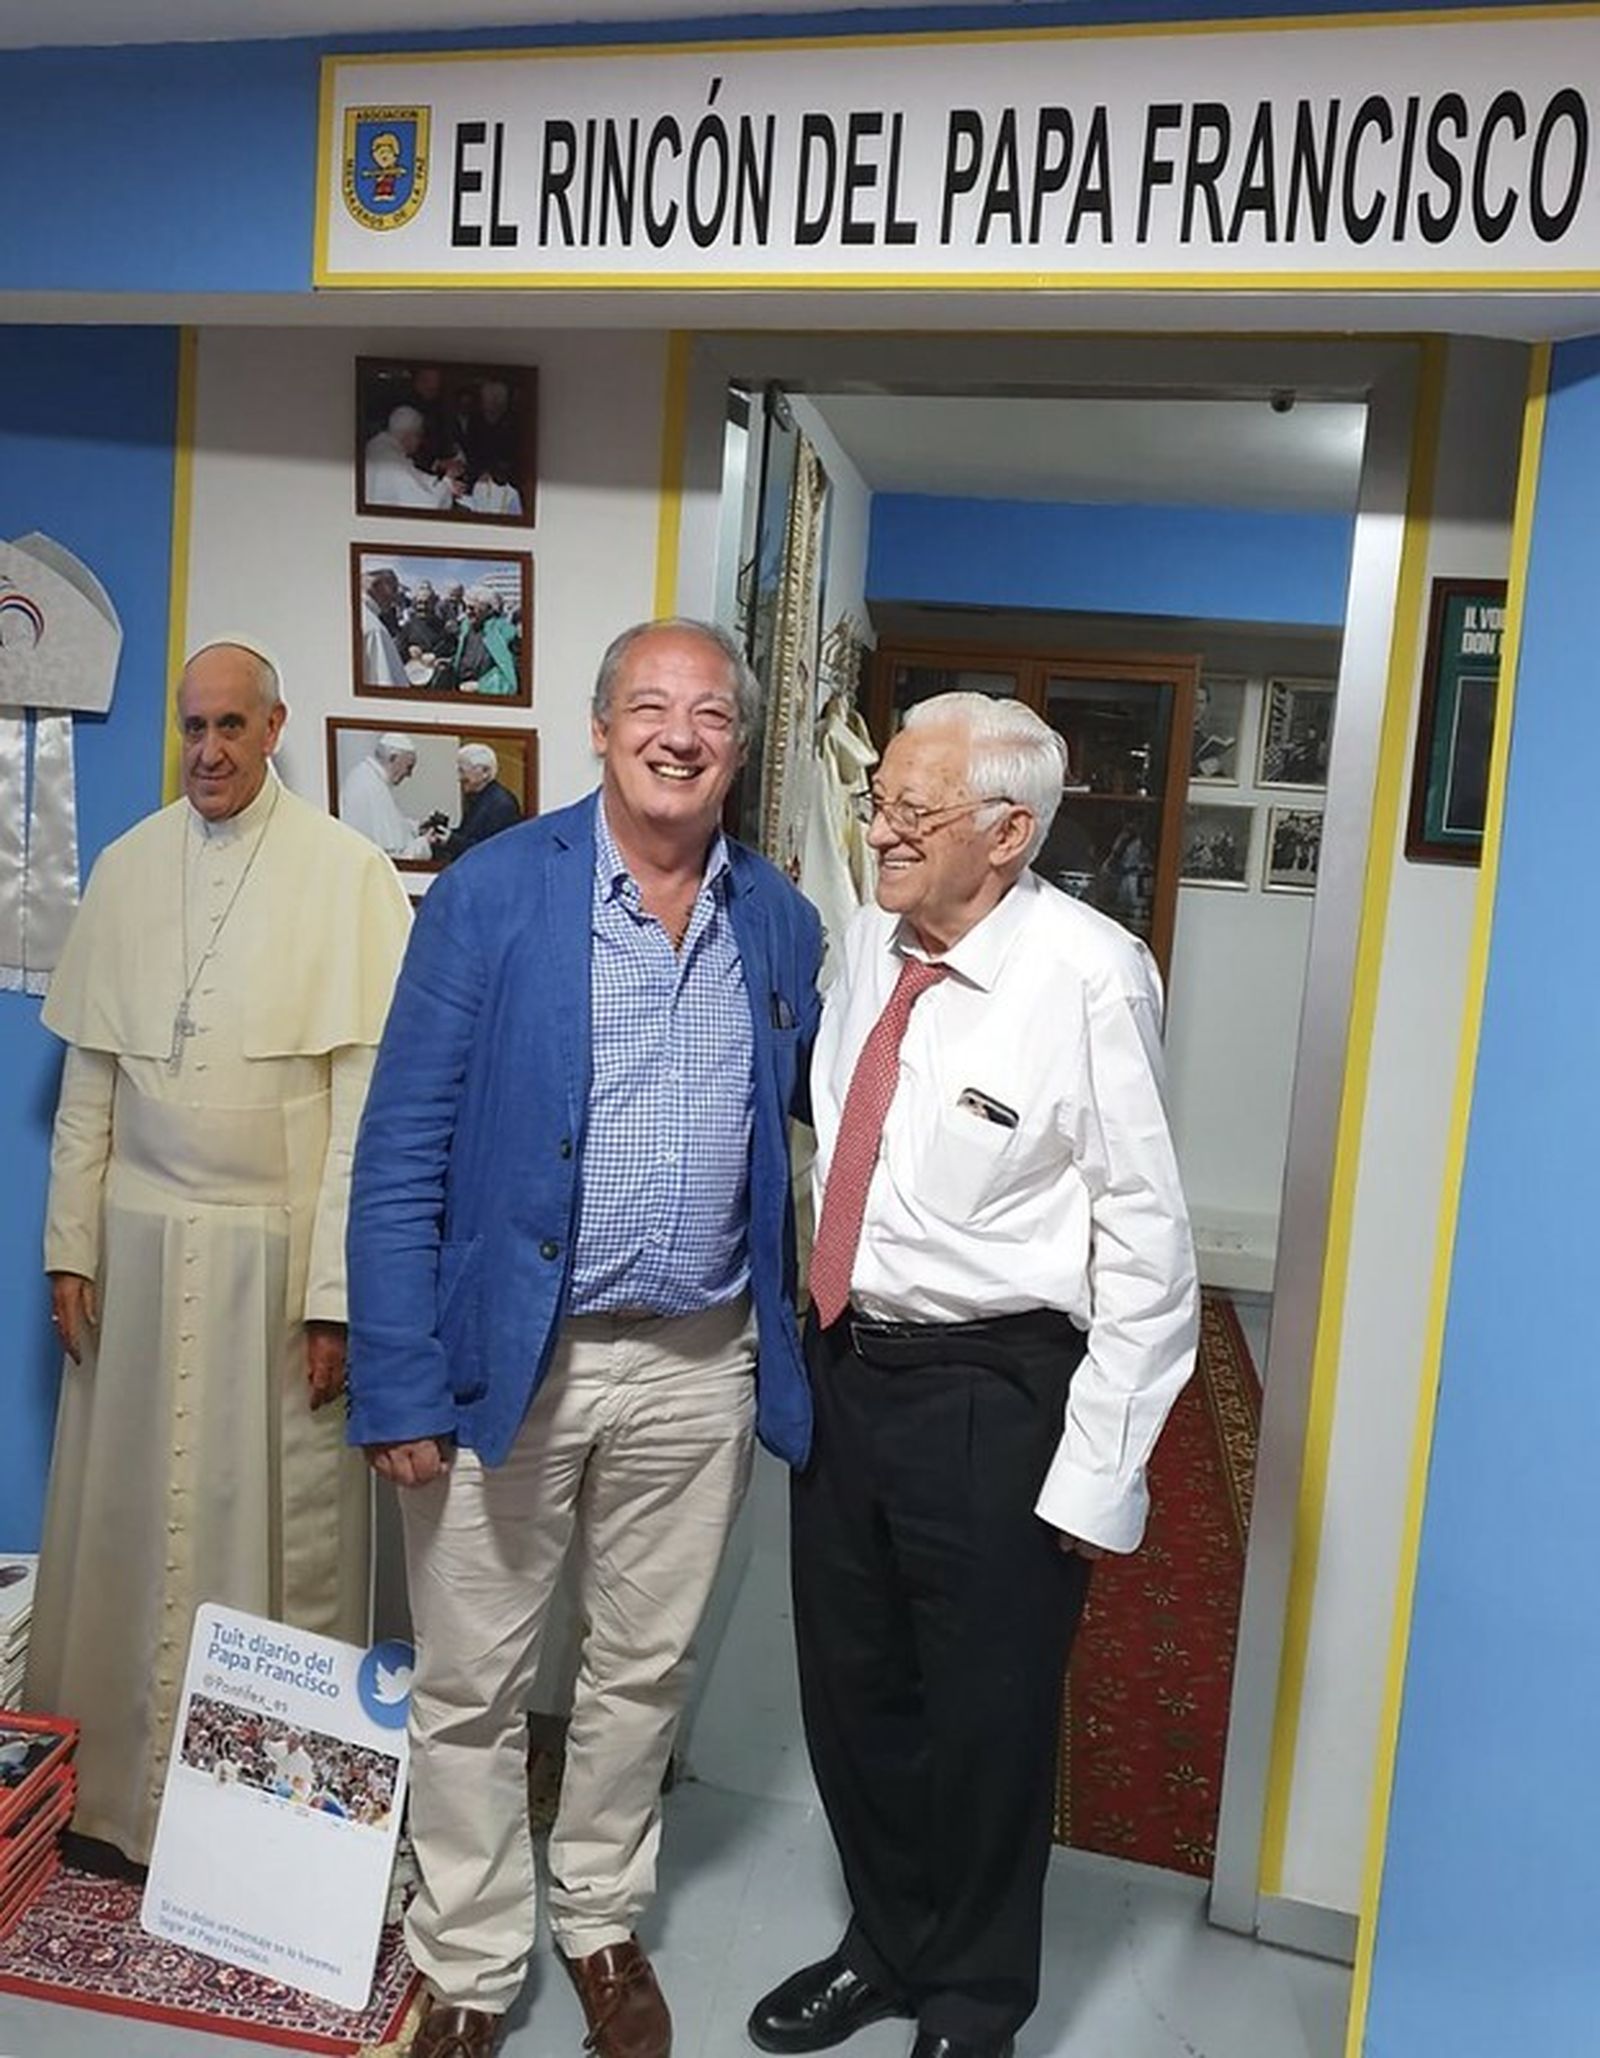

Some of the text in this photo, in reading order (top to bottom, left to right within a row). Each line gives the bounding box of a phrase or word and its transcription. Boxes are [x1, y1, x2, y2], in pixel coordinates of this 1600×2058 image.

[451, 78, 1588, 248] EL RINCÓN DEL PAPA FRANCISCO
[1461, 632, 1497, 655] DON
[207, 1641, 340, 1698] Papa Francisco
[211, 1621, 334, 1676] Tuit diario del
